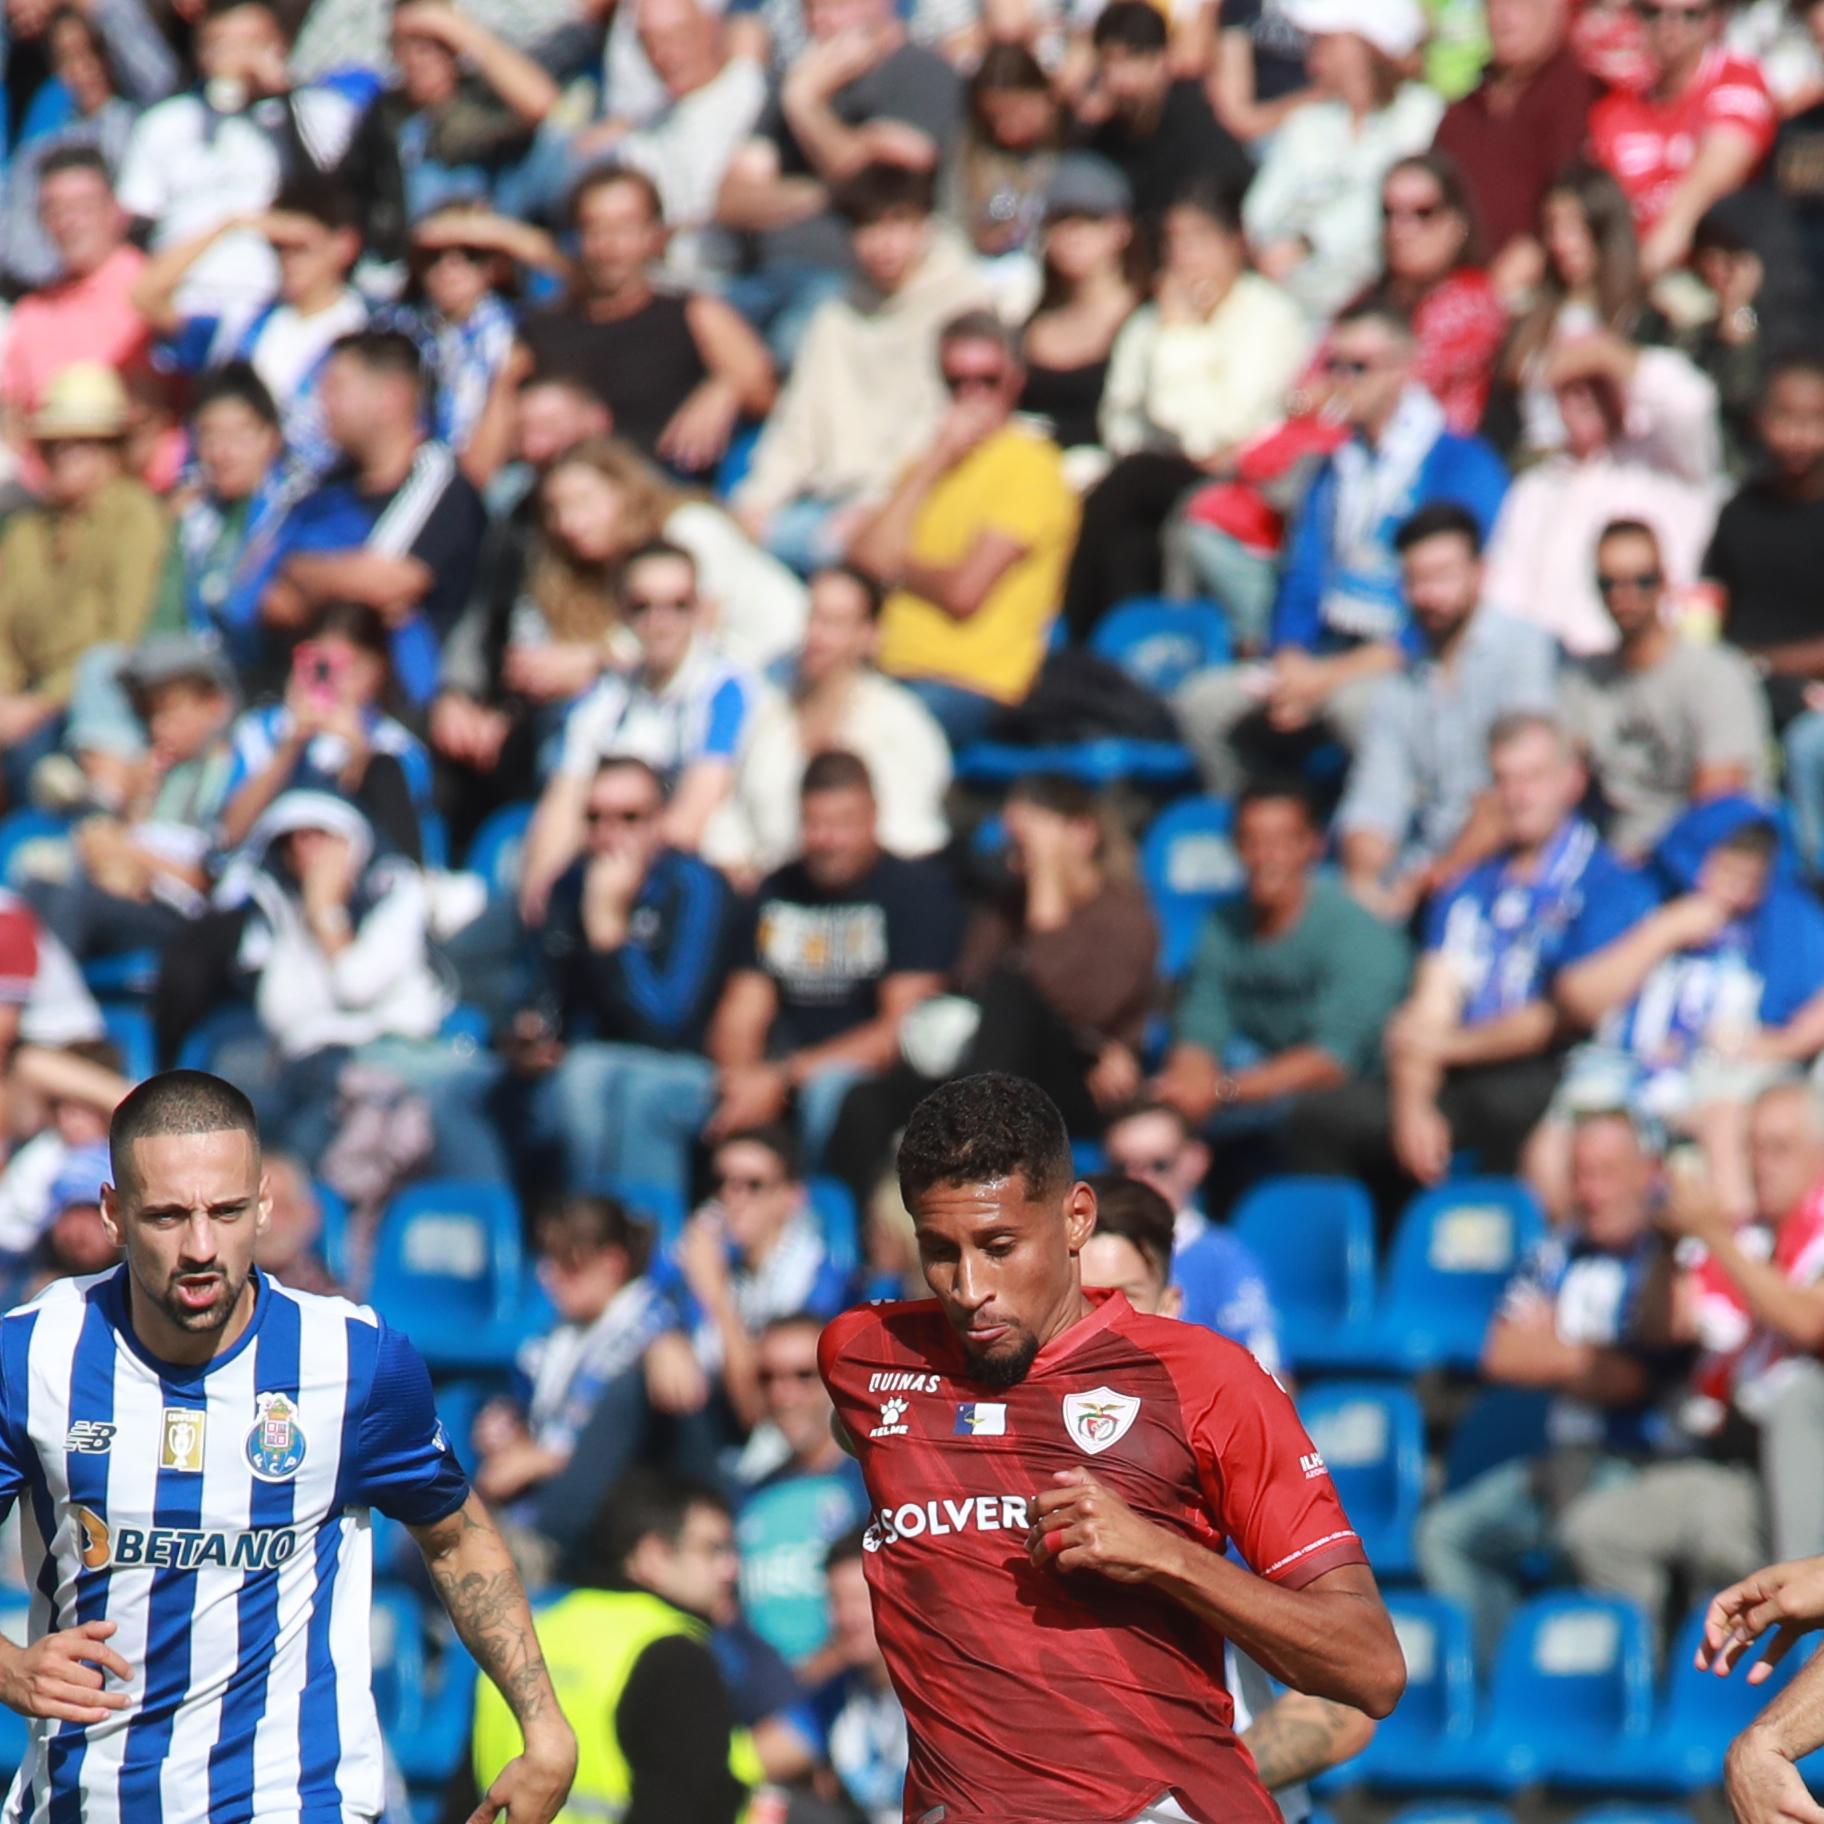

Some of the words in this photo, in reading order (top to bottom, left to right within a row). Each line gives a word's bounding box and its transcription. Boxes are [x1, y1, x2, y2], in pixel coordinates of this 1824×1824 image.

[869, 1372, 941, 1392] QUINAS
[880, 1495, 1036, 1544] SOLVER
[114, 1527, 297, 1570] BETANO
